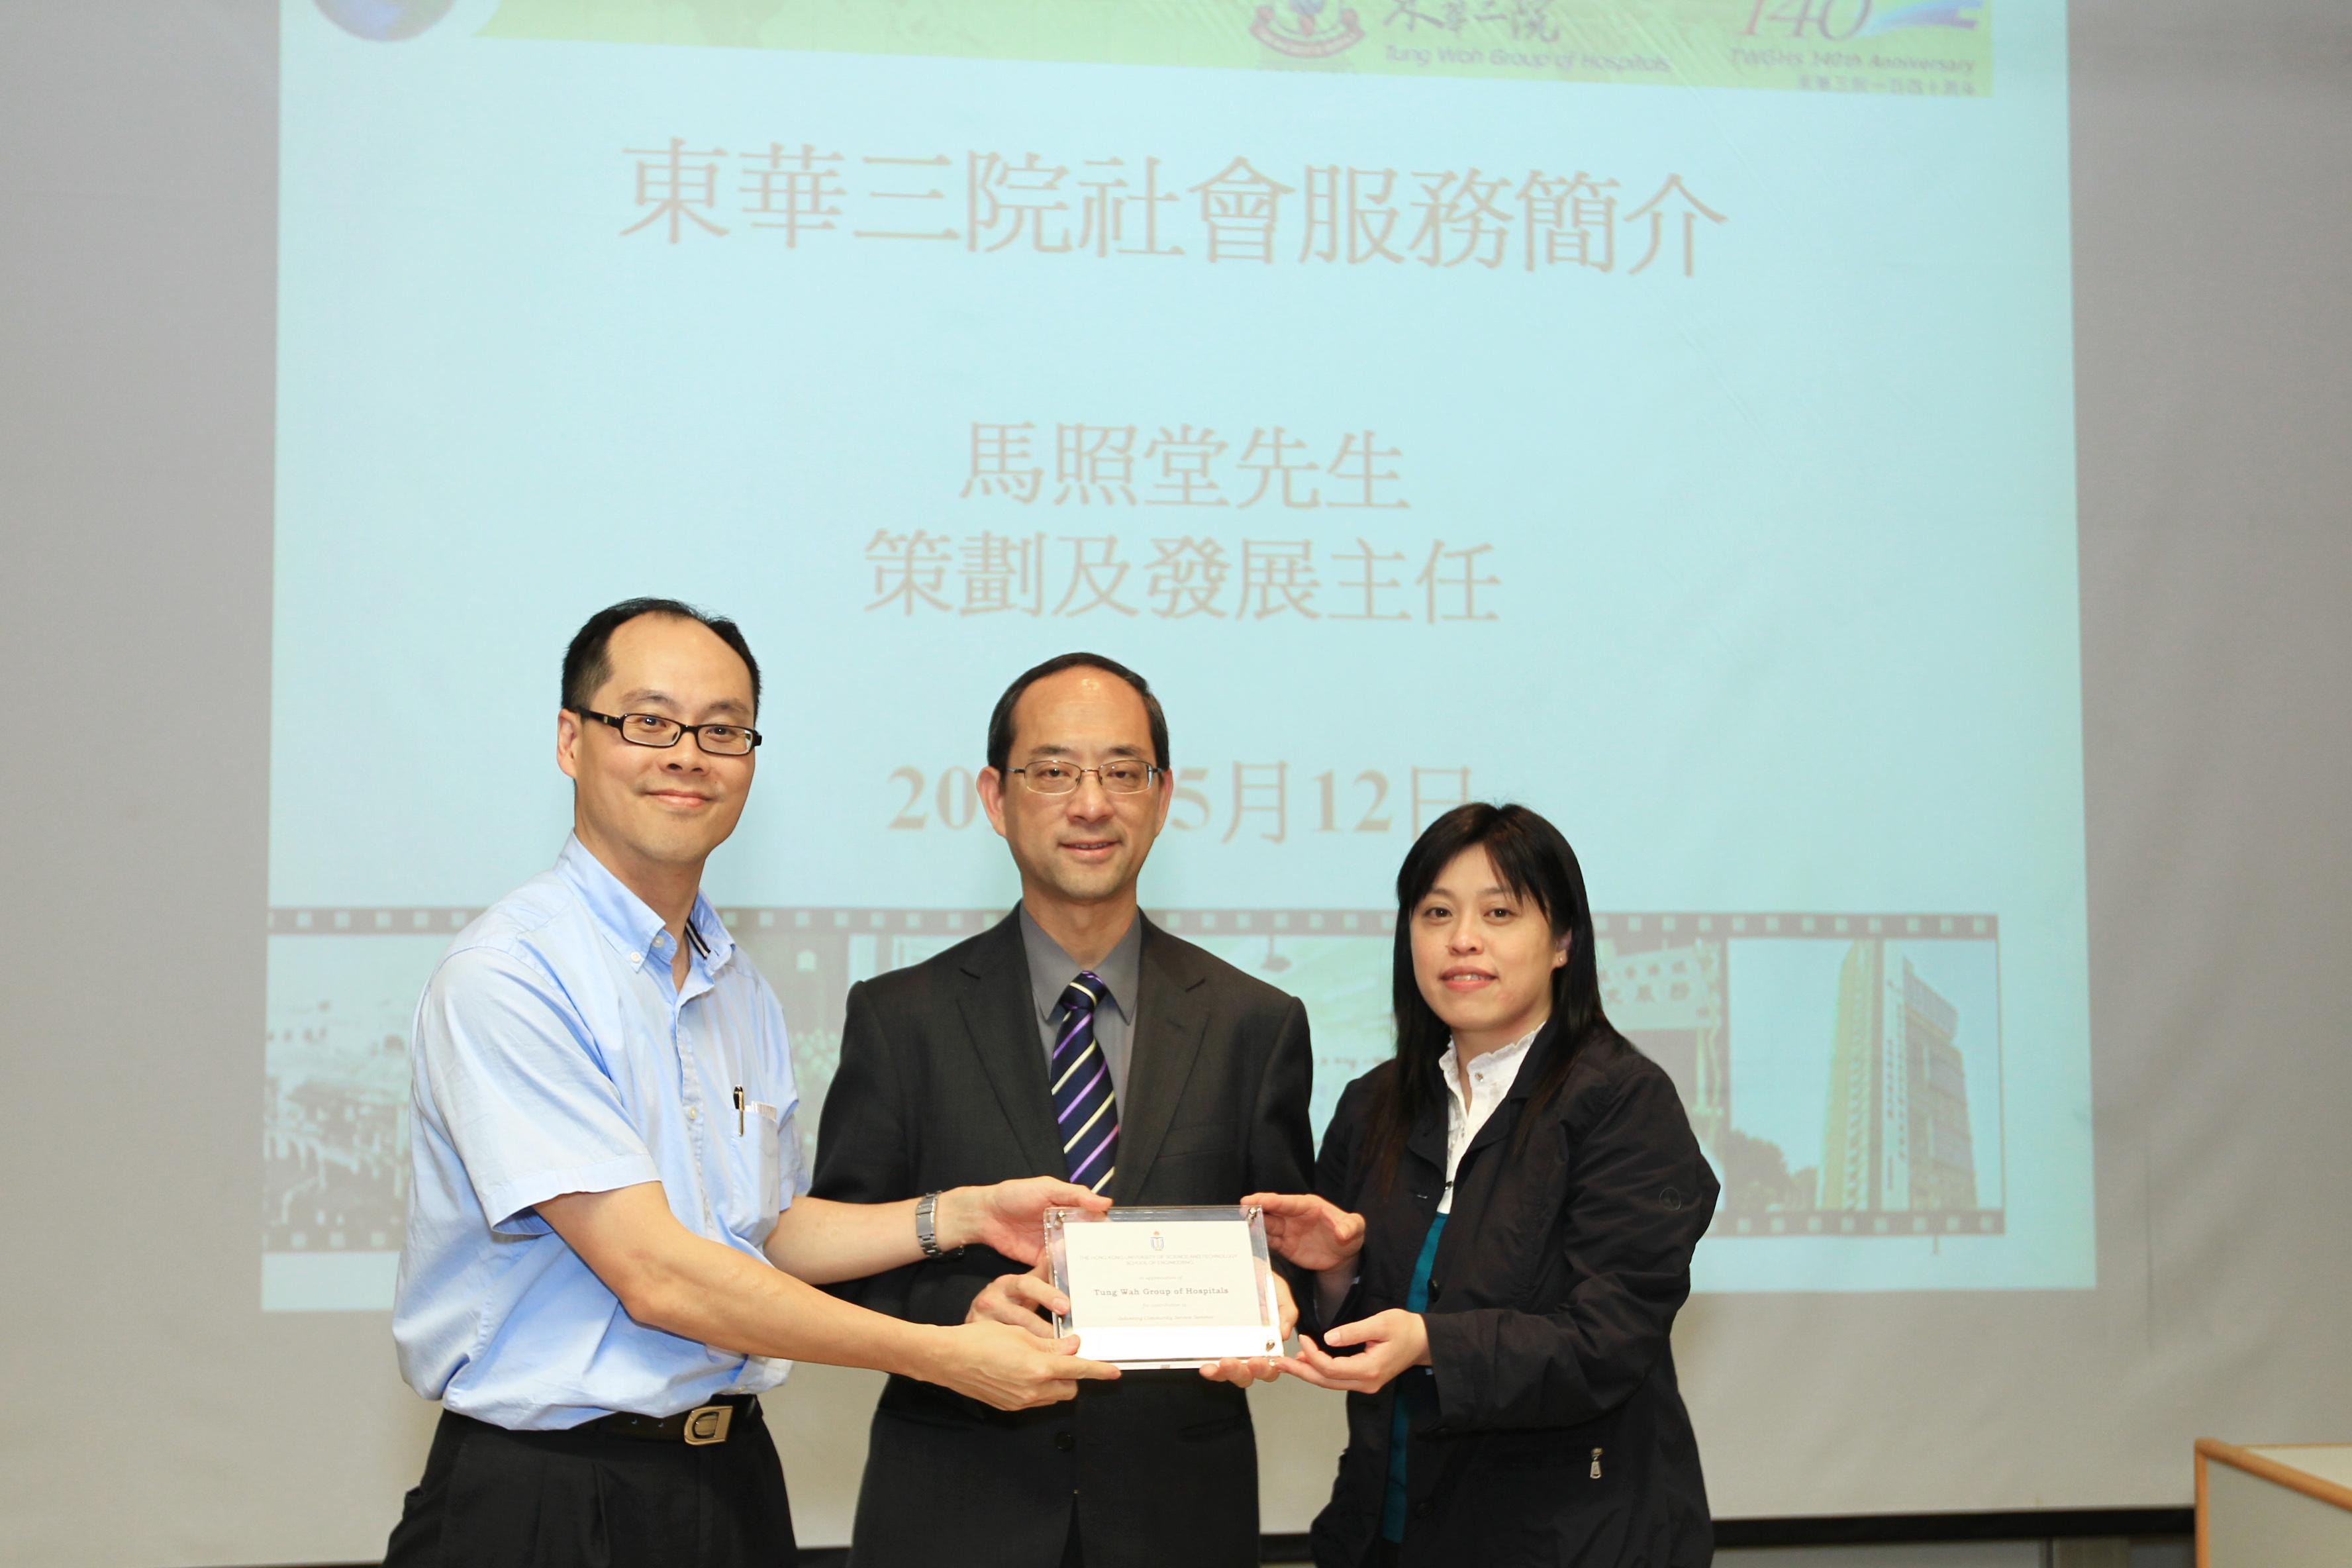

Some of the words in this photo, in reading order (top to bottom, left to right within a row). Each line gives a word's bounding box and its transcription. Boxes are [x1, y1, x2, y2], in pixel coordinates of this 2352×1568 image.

[1385, 44, 1431, 66] Tung
[1437, 46, 1484, 65] Wah
[1489, 48, 1551, 68] Group
[1555, 50, 1577, 70] of
[1580, 53, 1673, 72] Hospitals
[619, 137, 1729, 277] 東華三院社會服務簡介
[959, 420, 1412, 512] 馬照堂先生
[863, 528, 1502, 624] 策劃及發展主任
[1093, 1289, 1118, 1297] Tung
[1142, 1288, 1171, 1297] Group
[1185, 1287, 1229, 1297] Hospitals
